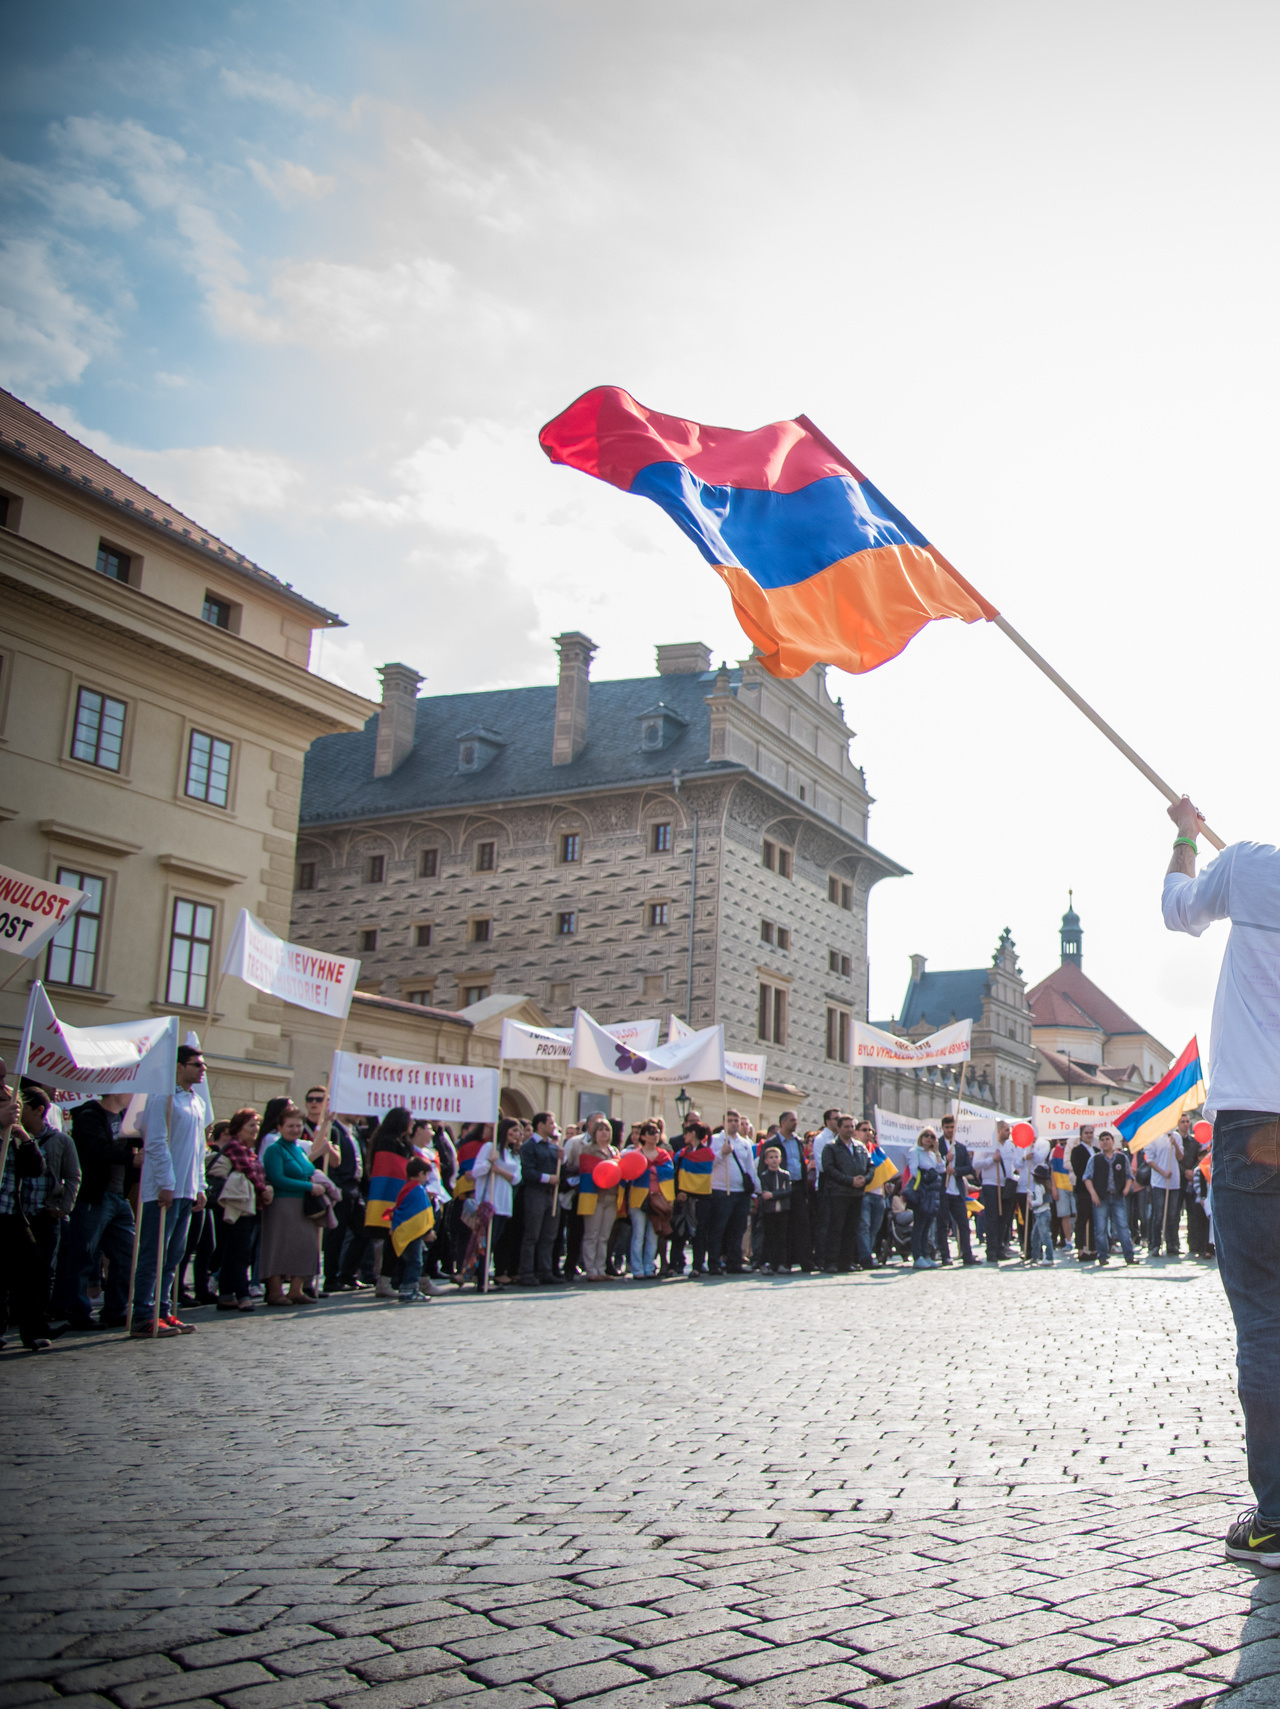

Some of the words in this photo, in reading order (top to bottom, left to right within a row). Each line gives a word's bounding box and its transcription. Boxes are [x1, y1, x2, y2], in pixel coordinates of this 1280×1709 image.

[287, 950, 346, 984] NEVYHNE
[858, 1043, 875, 1057] BYLO
[357, 1063, 404, 1084] TURECKO
[408, 1069, 420, 1085] SE
[424, 1070, 475, 1089] NEVYHNE
[367, 1091, 406, 1108] TRESTU
[410, 1095, 462, 1113] HISTORIE
[1040, 1105, 1051, 1114] To
[1053, 1105, 1095, 1116] Condemn
[1048, 1121, 1057, 1129] Is
[1060, 1121, 1070, 1130] To
